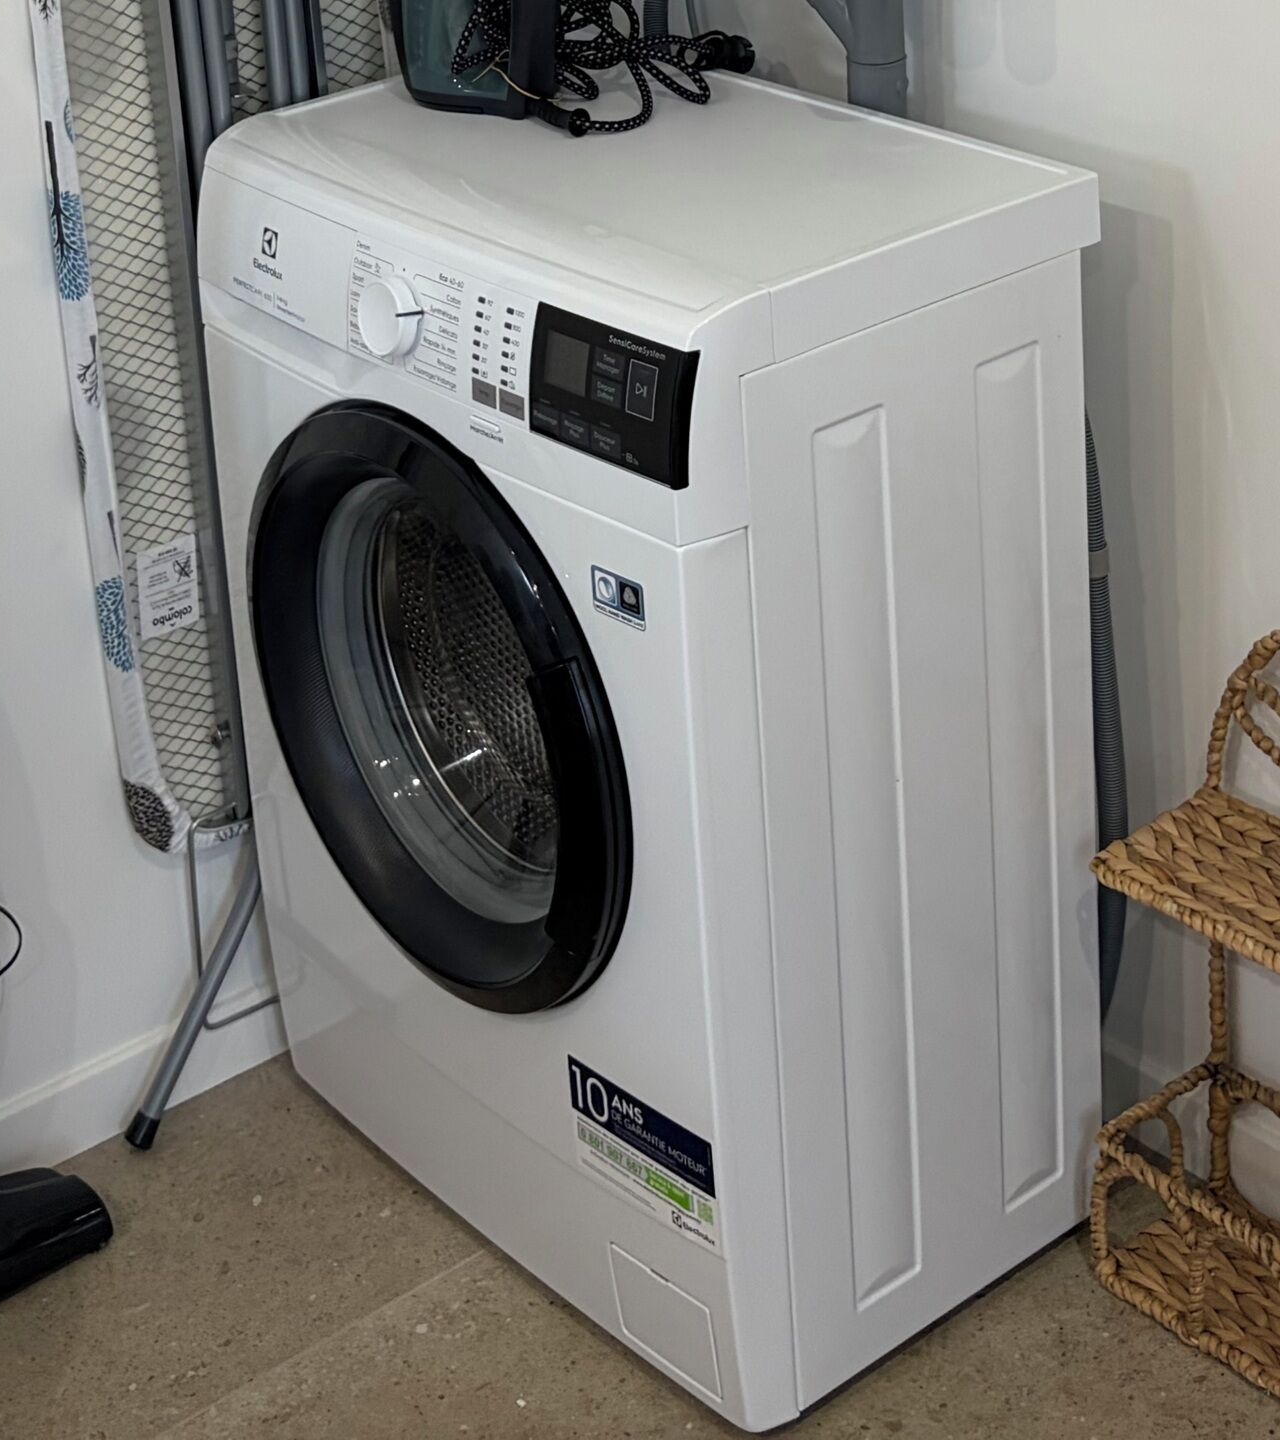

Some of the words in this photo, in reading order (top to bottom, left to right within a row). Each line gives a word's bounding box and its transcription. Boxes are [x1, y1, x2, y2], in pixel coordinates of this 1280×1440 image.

[253, 257, 283, 280] Electrolux
[609, 334, 666, 361] SensiCareSystem
[152, 605, 193, 626] colombo
[572, 1064, 609, 1124] 10
[611, 1094, 644, 1125] ANS
[611, 1111, 622, 1125] DE
[624, 1116, 667, 1151] GARANTIE
[682, 1221, 716, 1247] Electrolux
